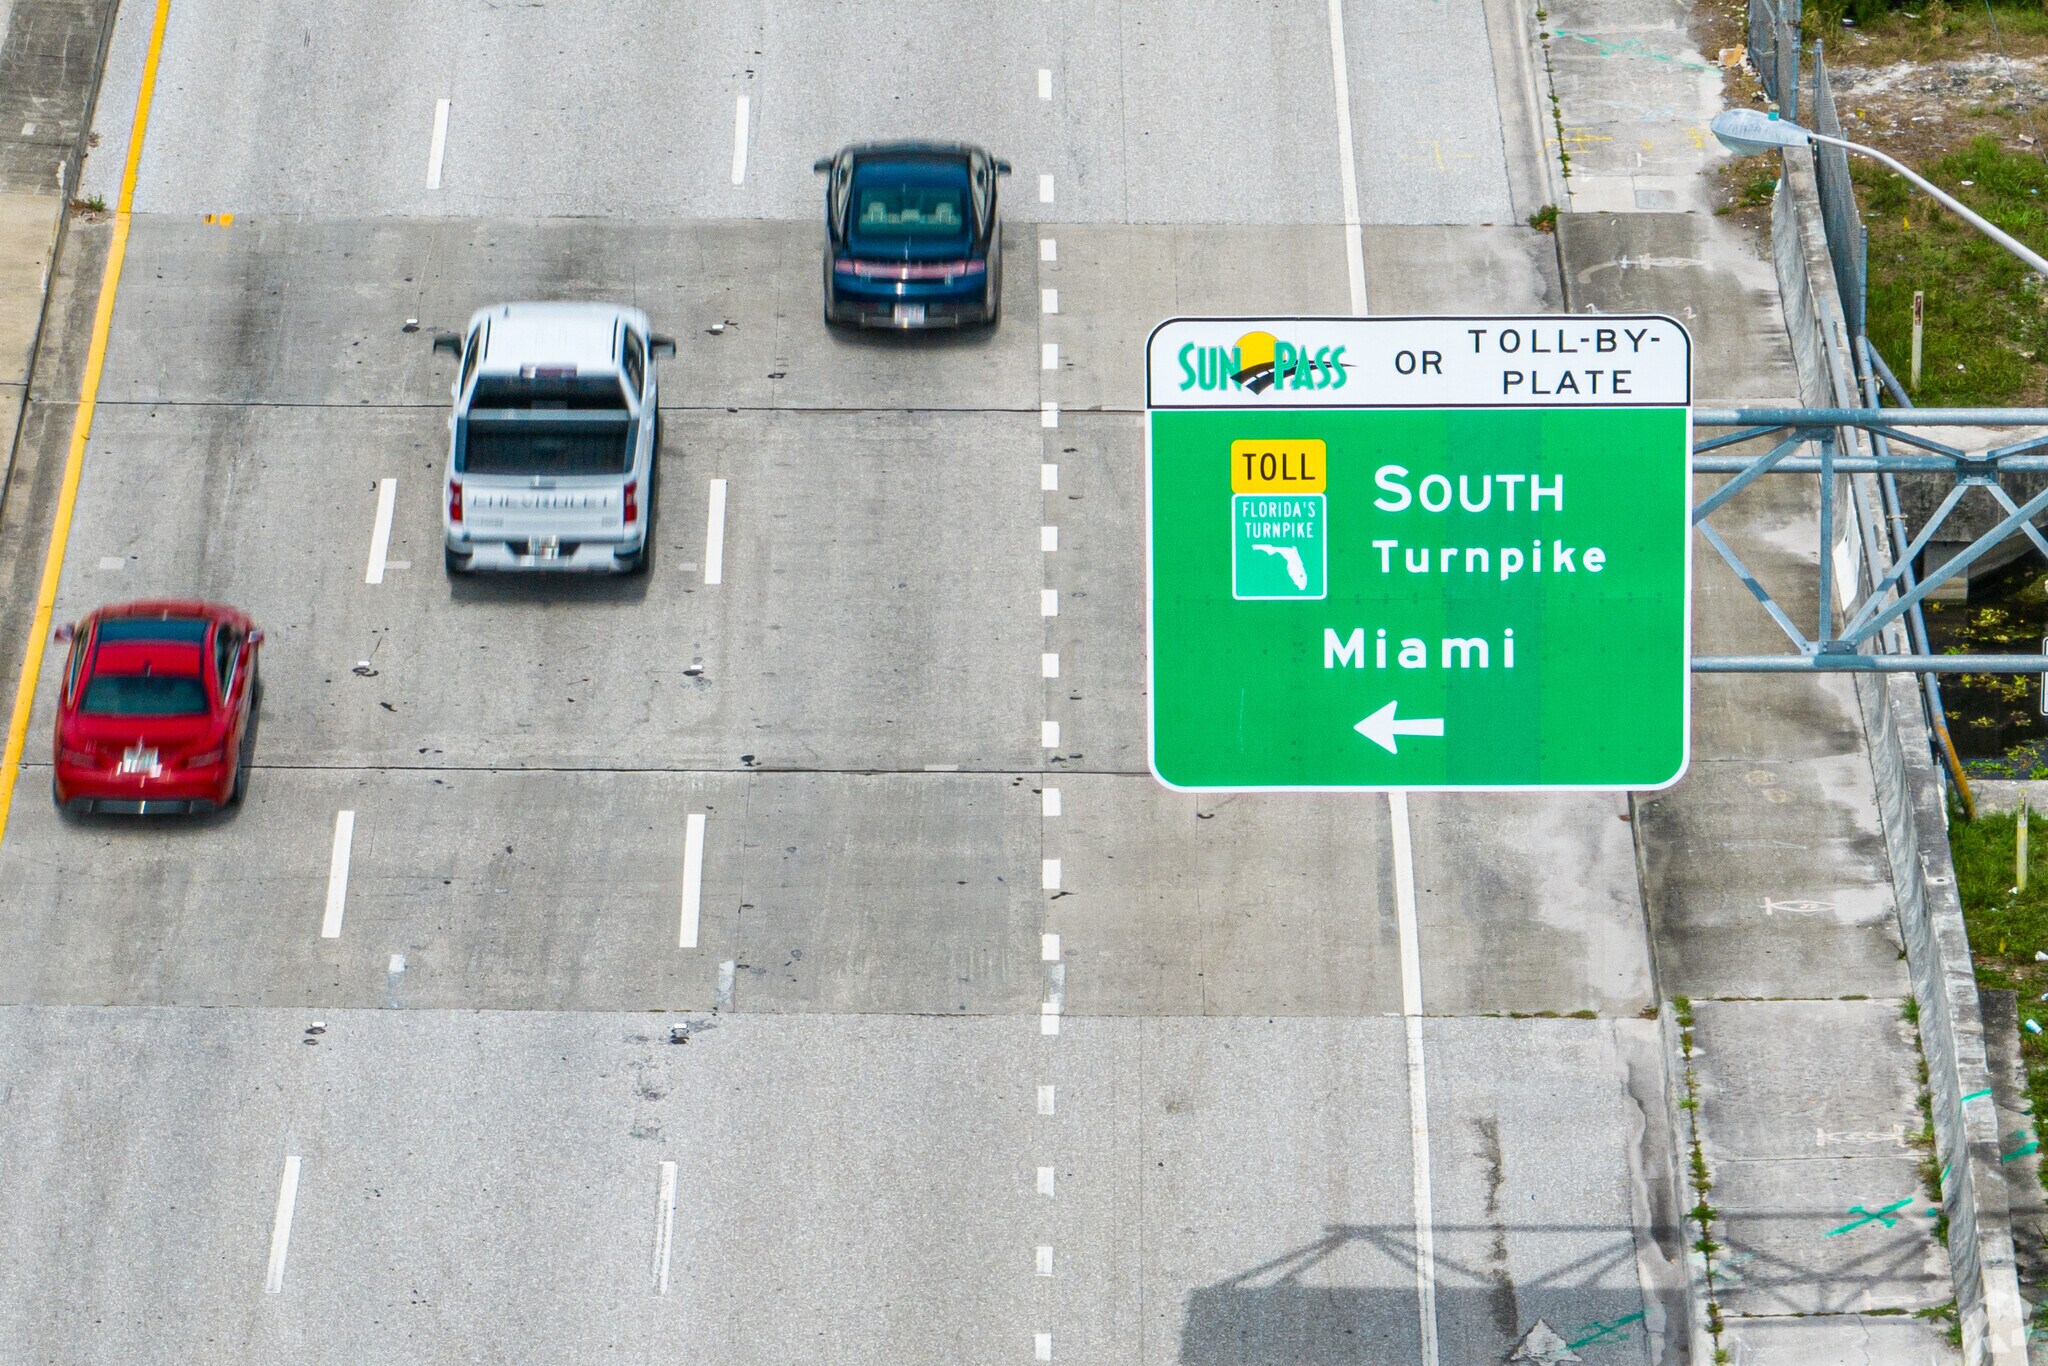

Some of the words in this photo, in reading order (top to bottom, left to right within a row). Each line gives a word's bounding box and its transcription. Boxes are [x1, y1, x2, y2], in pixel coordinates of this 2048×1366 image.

[1467, 328, 1660, 354] TOLL-BY-
[1395, 350, 1442, 375] OR
[1503, 370, 1632, 395] PLATE
[1242, 452, 1316, 482] TOLL
[1373, 464, 1563, 513] SOUTH
[1242, 501, 1316, 518] FLORIDA'S
[1245, 521, 1313, 539] TURNPIKE
[1372, 539, 1606, 581] Turnpike
[1324, 628, 1514, 669] Miami
